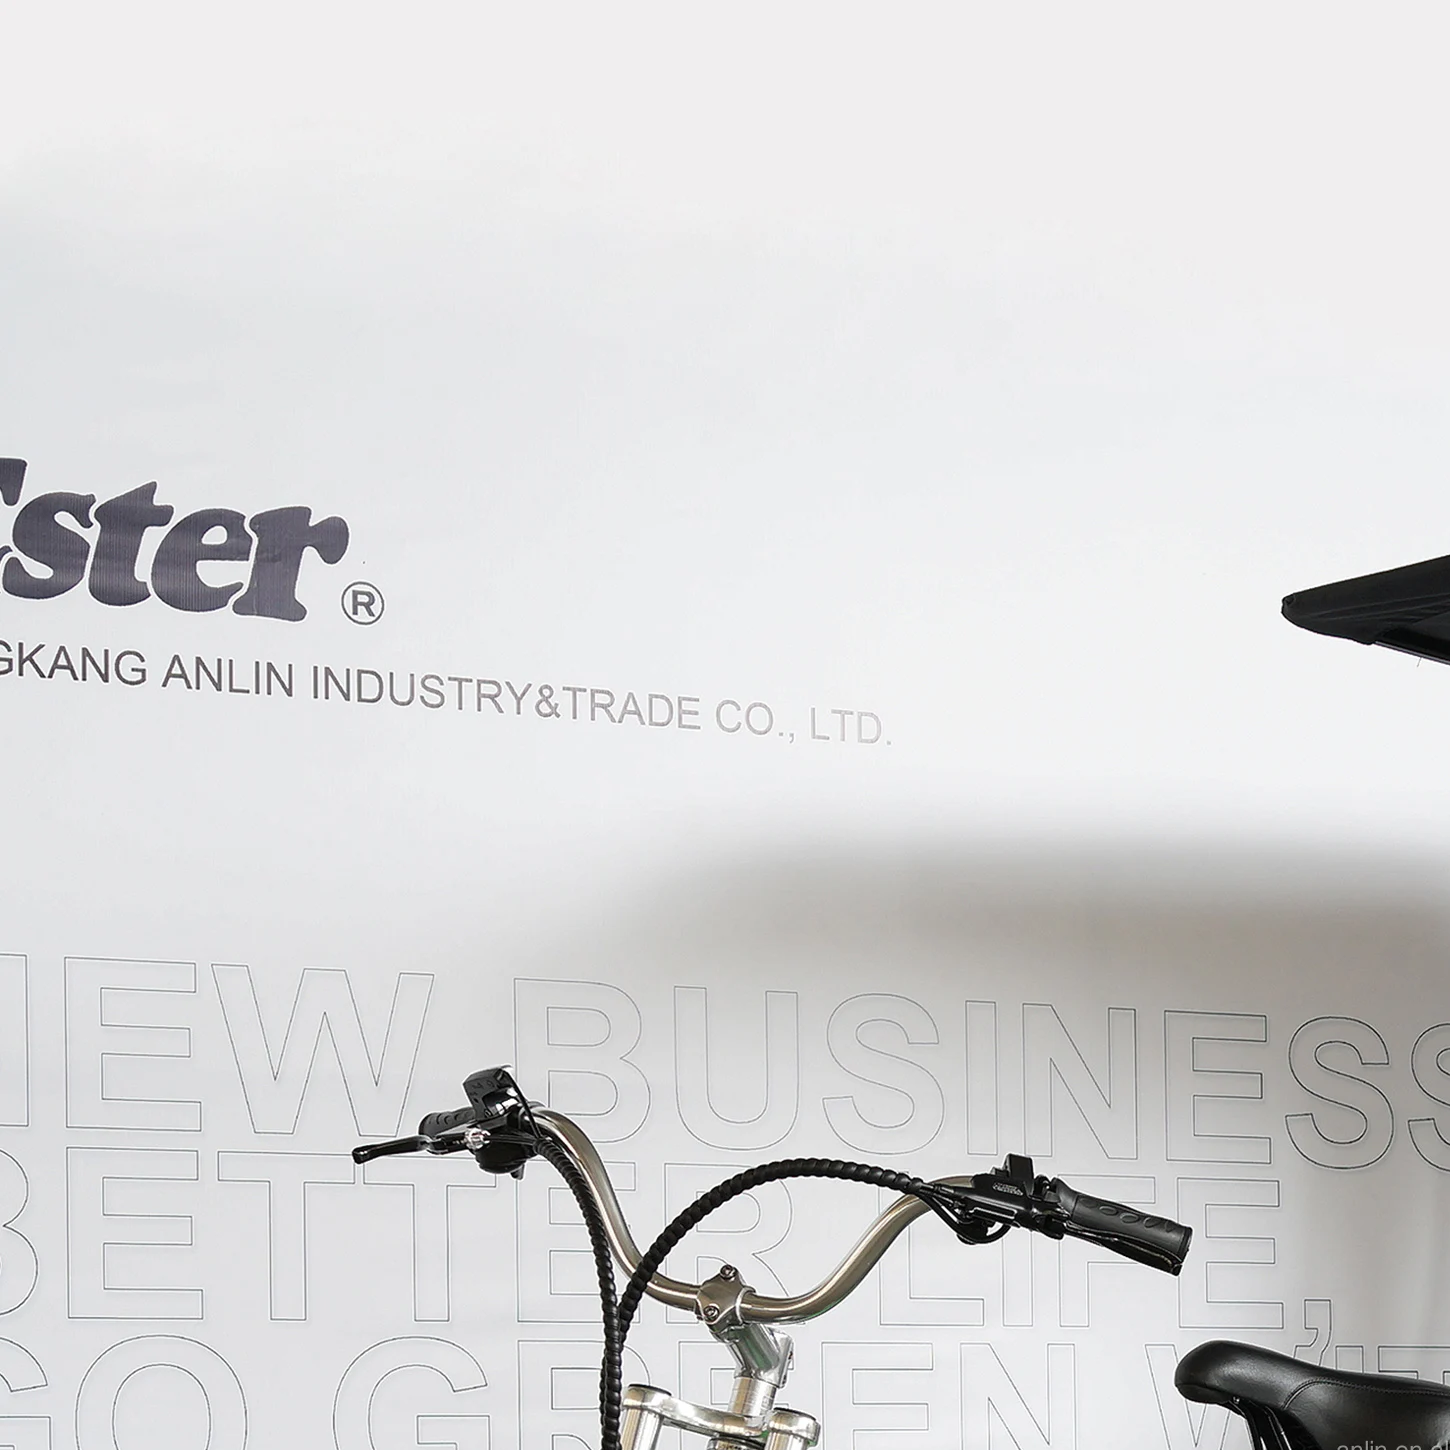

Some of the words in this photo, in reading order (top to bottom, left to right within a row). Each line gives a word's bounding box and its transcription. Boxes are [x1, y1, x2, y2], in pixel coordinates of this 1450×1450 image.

[0, 457, 349, 622] ster
[161, 654, 293, 698] ANLIN
[312, 664, 700, 731] INDUSTRY&TRADE
[715, 699, 796, 744] CO.,
[810, 706, 892, 746] LTD.
[0, 953, 435, 1138] EW
